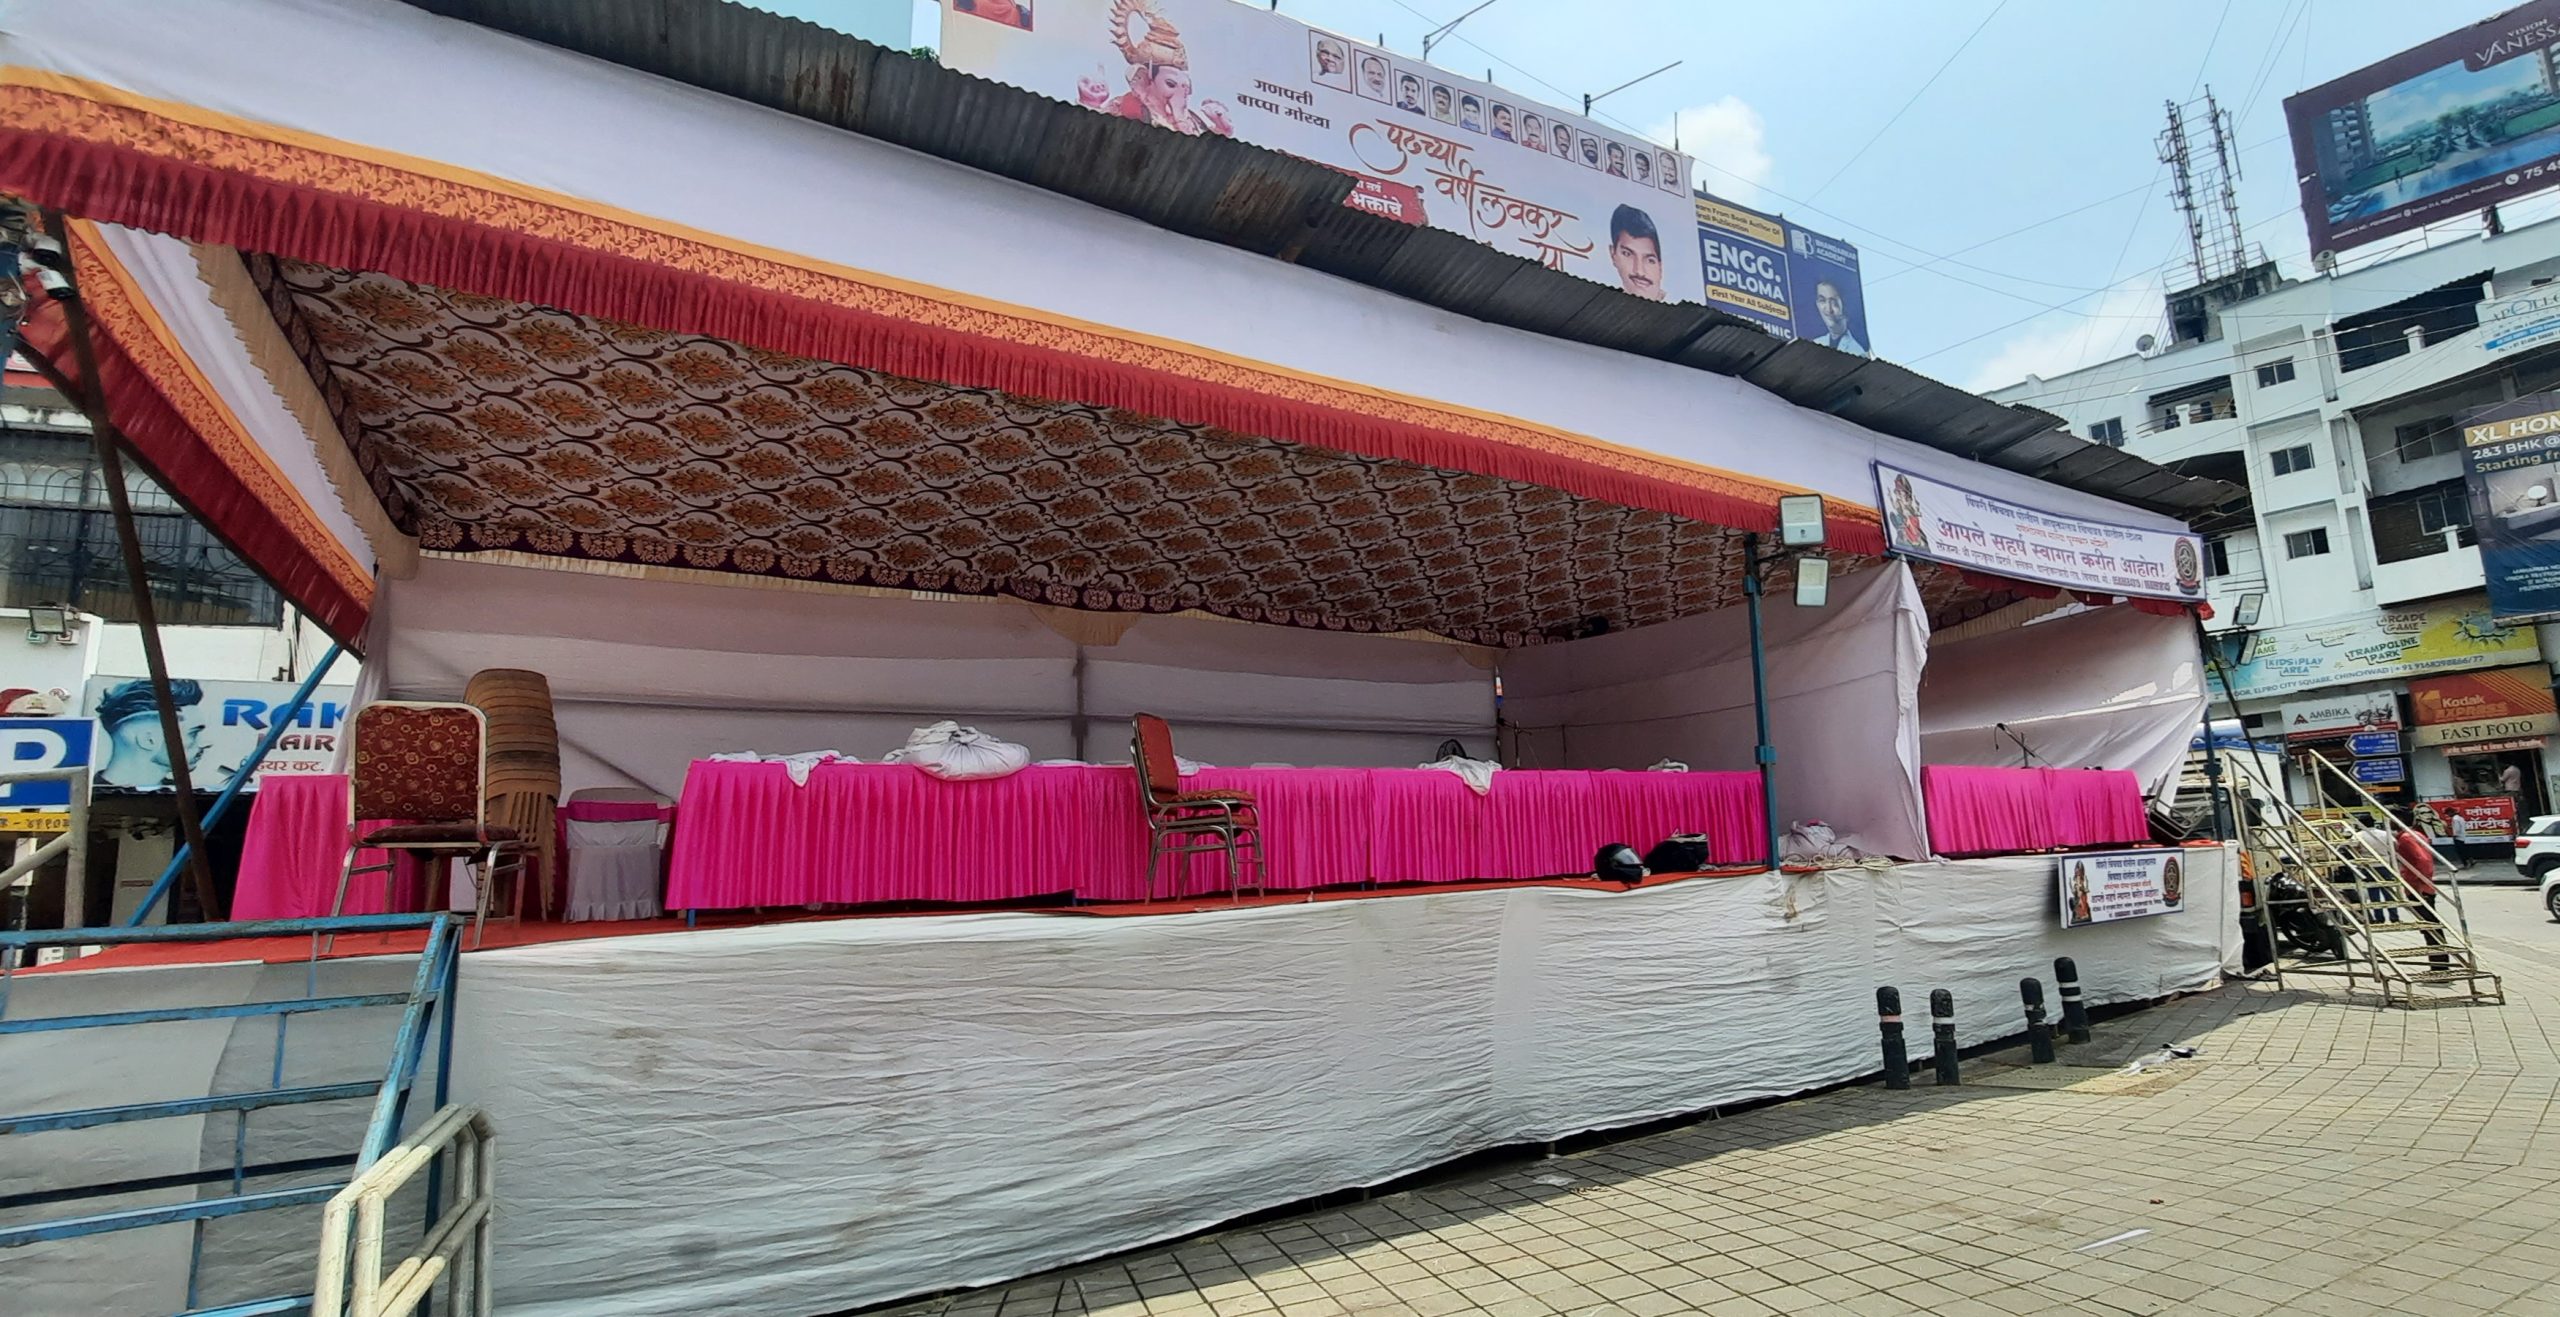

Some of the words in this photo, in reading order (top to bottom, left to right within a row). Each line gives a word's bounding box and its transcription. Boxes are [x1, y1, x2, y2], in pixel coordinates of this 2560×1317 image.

[2507, 18, 2548, 37] VISION
[2475, 22, 2560, 66] VANESS
[1254, 79, 1313, 107] गणपती
[1236, 92, 1280, 116] बाप्पा
[1285, 107, 1331, 131] मोरया
[2523, 165, 2544, 180] 75
[1703, 238, 1782, 283] ENGG.
[1707, 265, 1785, 303] DIPLOMA
[1711, 289, 1728, 299] First
[1729, 293, 1746, 304] Year
[1757, 301, 1787, 317] Subjects
[2472, 426, 2503, 444] XL
[2472, 446, 2502, 460] 2&3
[2505, 438, 2542, 454] BHK
[2475, 454, 2542, 473] Starting
[1937, 517, 1987, 547] आपले
[1989, 533, 2028, 557] सहर्ष
[2029, 542, 2077, 566] स्वागत
[2079, 548, 2118, 572] करीत
[2120, 553, 2165, 579] आहोत!
[2380, 613, 2426, 624] ARCADE
[2386, 622, 2420, 632] GAME
[2257, 645, 2277, 655] AME
[2348, 637, 2418, 658] TRAMPOLINE
[2369, 650, 2400, 662] PARK
[2254, 685, 2279, 694] ELPRO
[2334, 665, 2389, 681] CHINCHWAD
[2282, 666, 2310, 674] AREA
[2442, 694, 2486, 708] Kodak
[2309, 707, 2351, 719] AMBIKA
[2434, 702, 2508, 721] EXPRESS
[2441, 726, 2481, 740] FAST
[2487, 720, 2533, 736] FOTO
